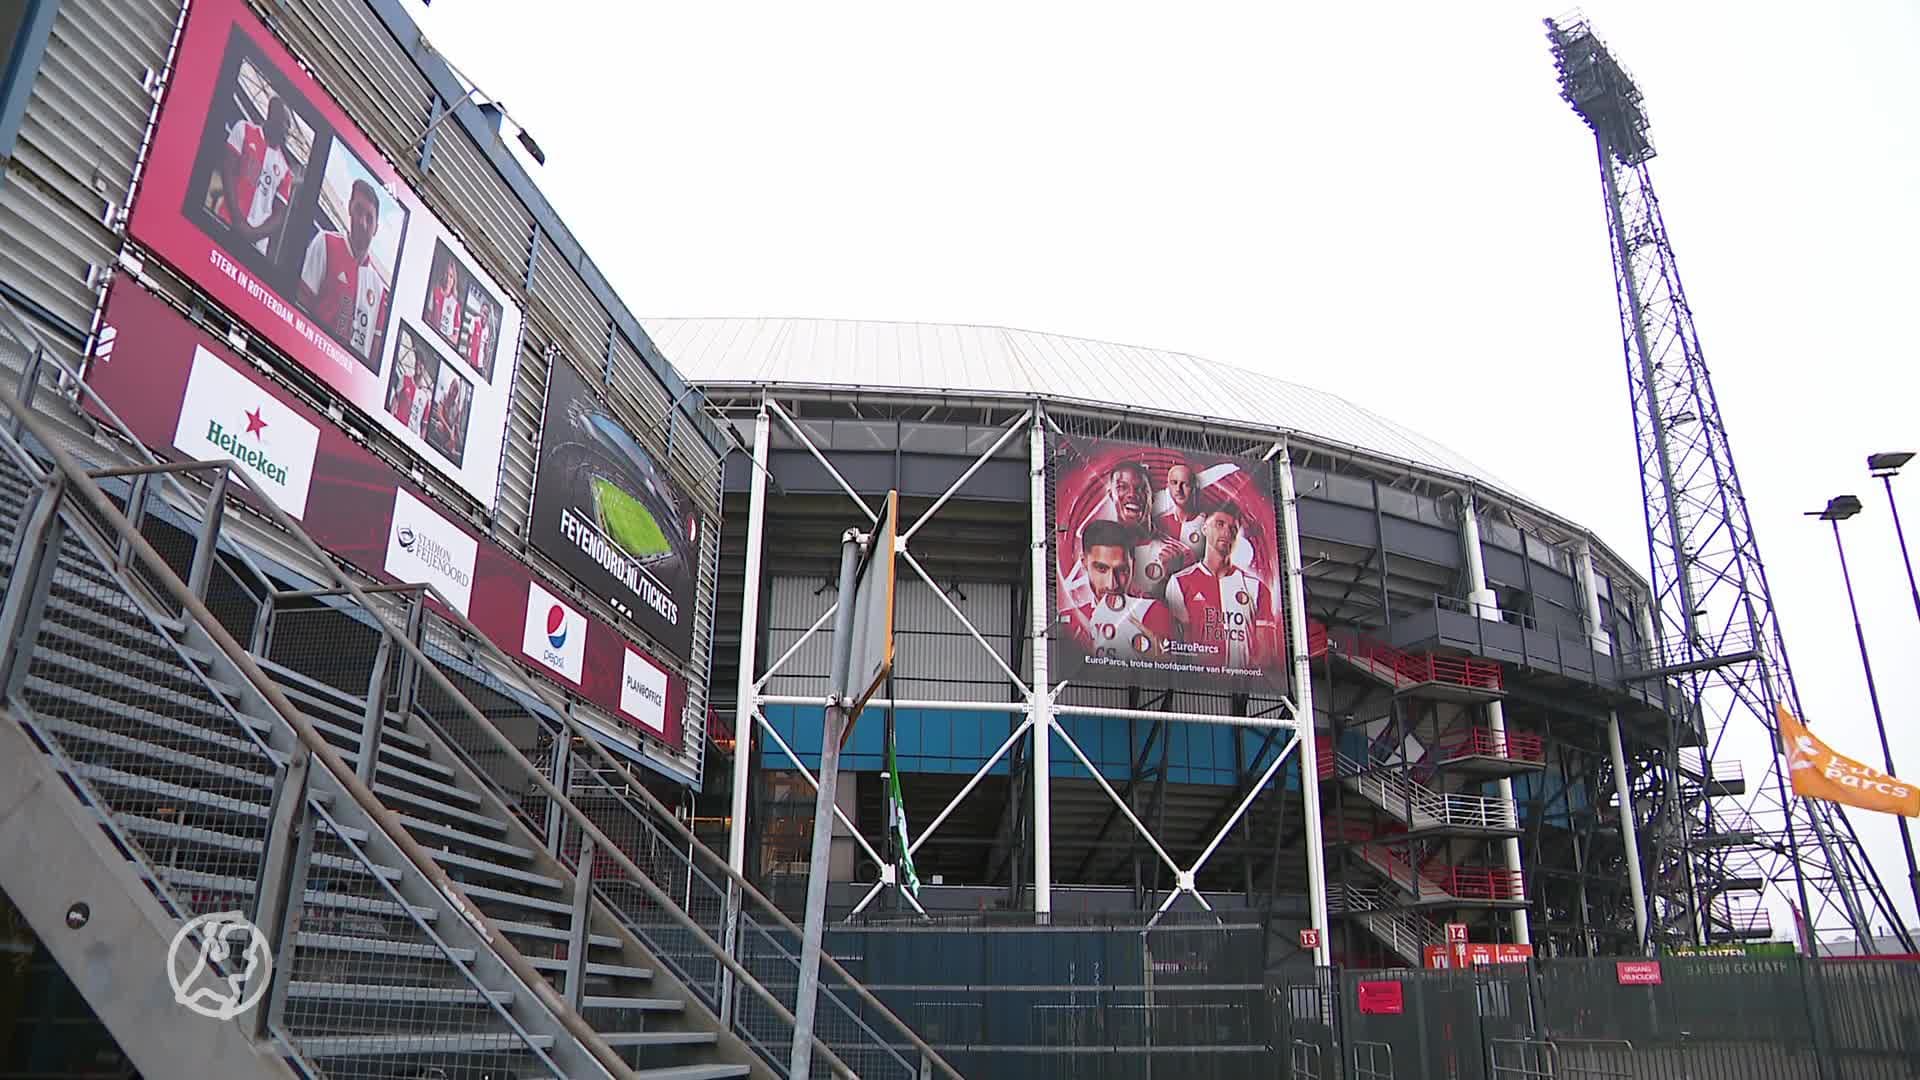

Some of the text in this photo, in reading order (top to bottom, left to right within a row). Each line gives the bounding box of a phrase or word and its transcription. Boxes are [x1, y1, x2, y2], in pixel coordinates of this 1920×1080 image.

[210, 250, 236, 281] STERK
[237, 271, 248, 289] IN
[206, 419, 287, 486] Heineken
[418, 534, 452, 562] STADION
[415, 544, 470, 588] FEIJENOORD
[560, 508, 679, 626] FEYENOORD.NL/TICKETS
[1205, 607, 1244, 626] Euro
[1170, 640, 1219, 654] EuroParcs
[543, 650, 566, 670] pepsi
[1085, 656, 1263, 678] EuroParcs, trotse hoofdpartner van Feyenoord.
[1824, 767, 1909, 798] Parcs
[1302, 934, 1317, 945] 13
[1450, 927, 1466, 939] 14
